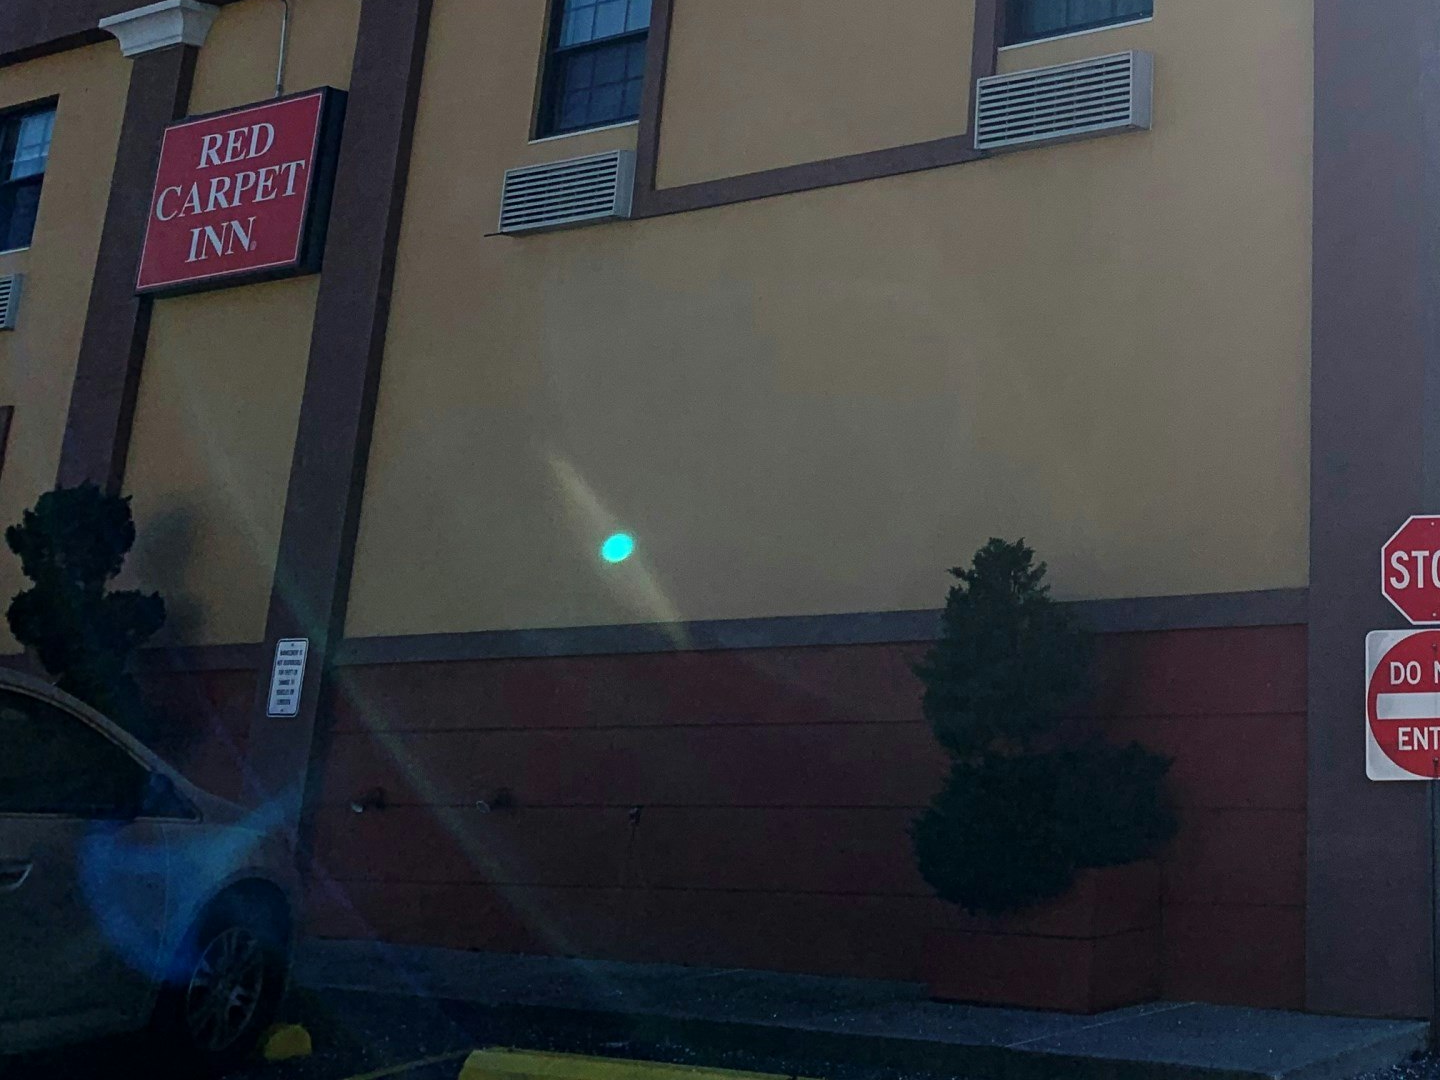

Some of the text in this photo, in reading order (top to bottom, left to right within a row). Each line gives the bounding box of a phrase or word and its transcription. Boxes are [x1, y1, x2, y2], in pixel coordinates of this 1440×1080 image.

[196, 122, 275, 170] RED
[155, 160, 305, 222] CARPET
[1389, 661, 1422, 685] DO
